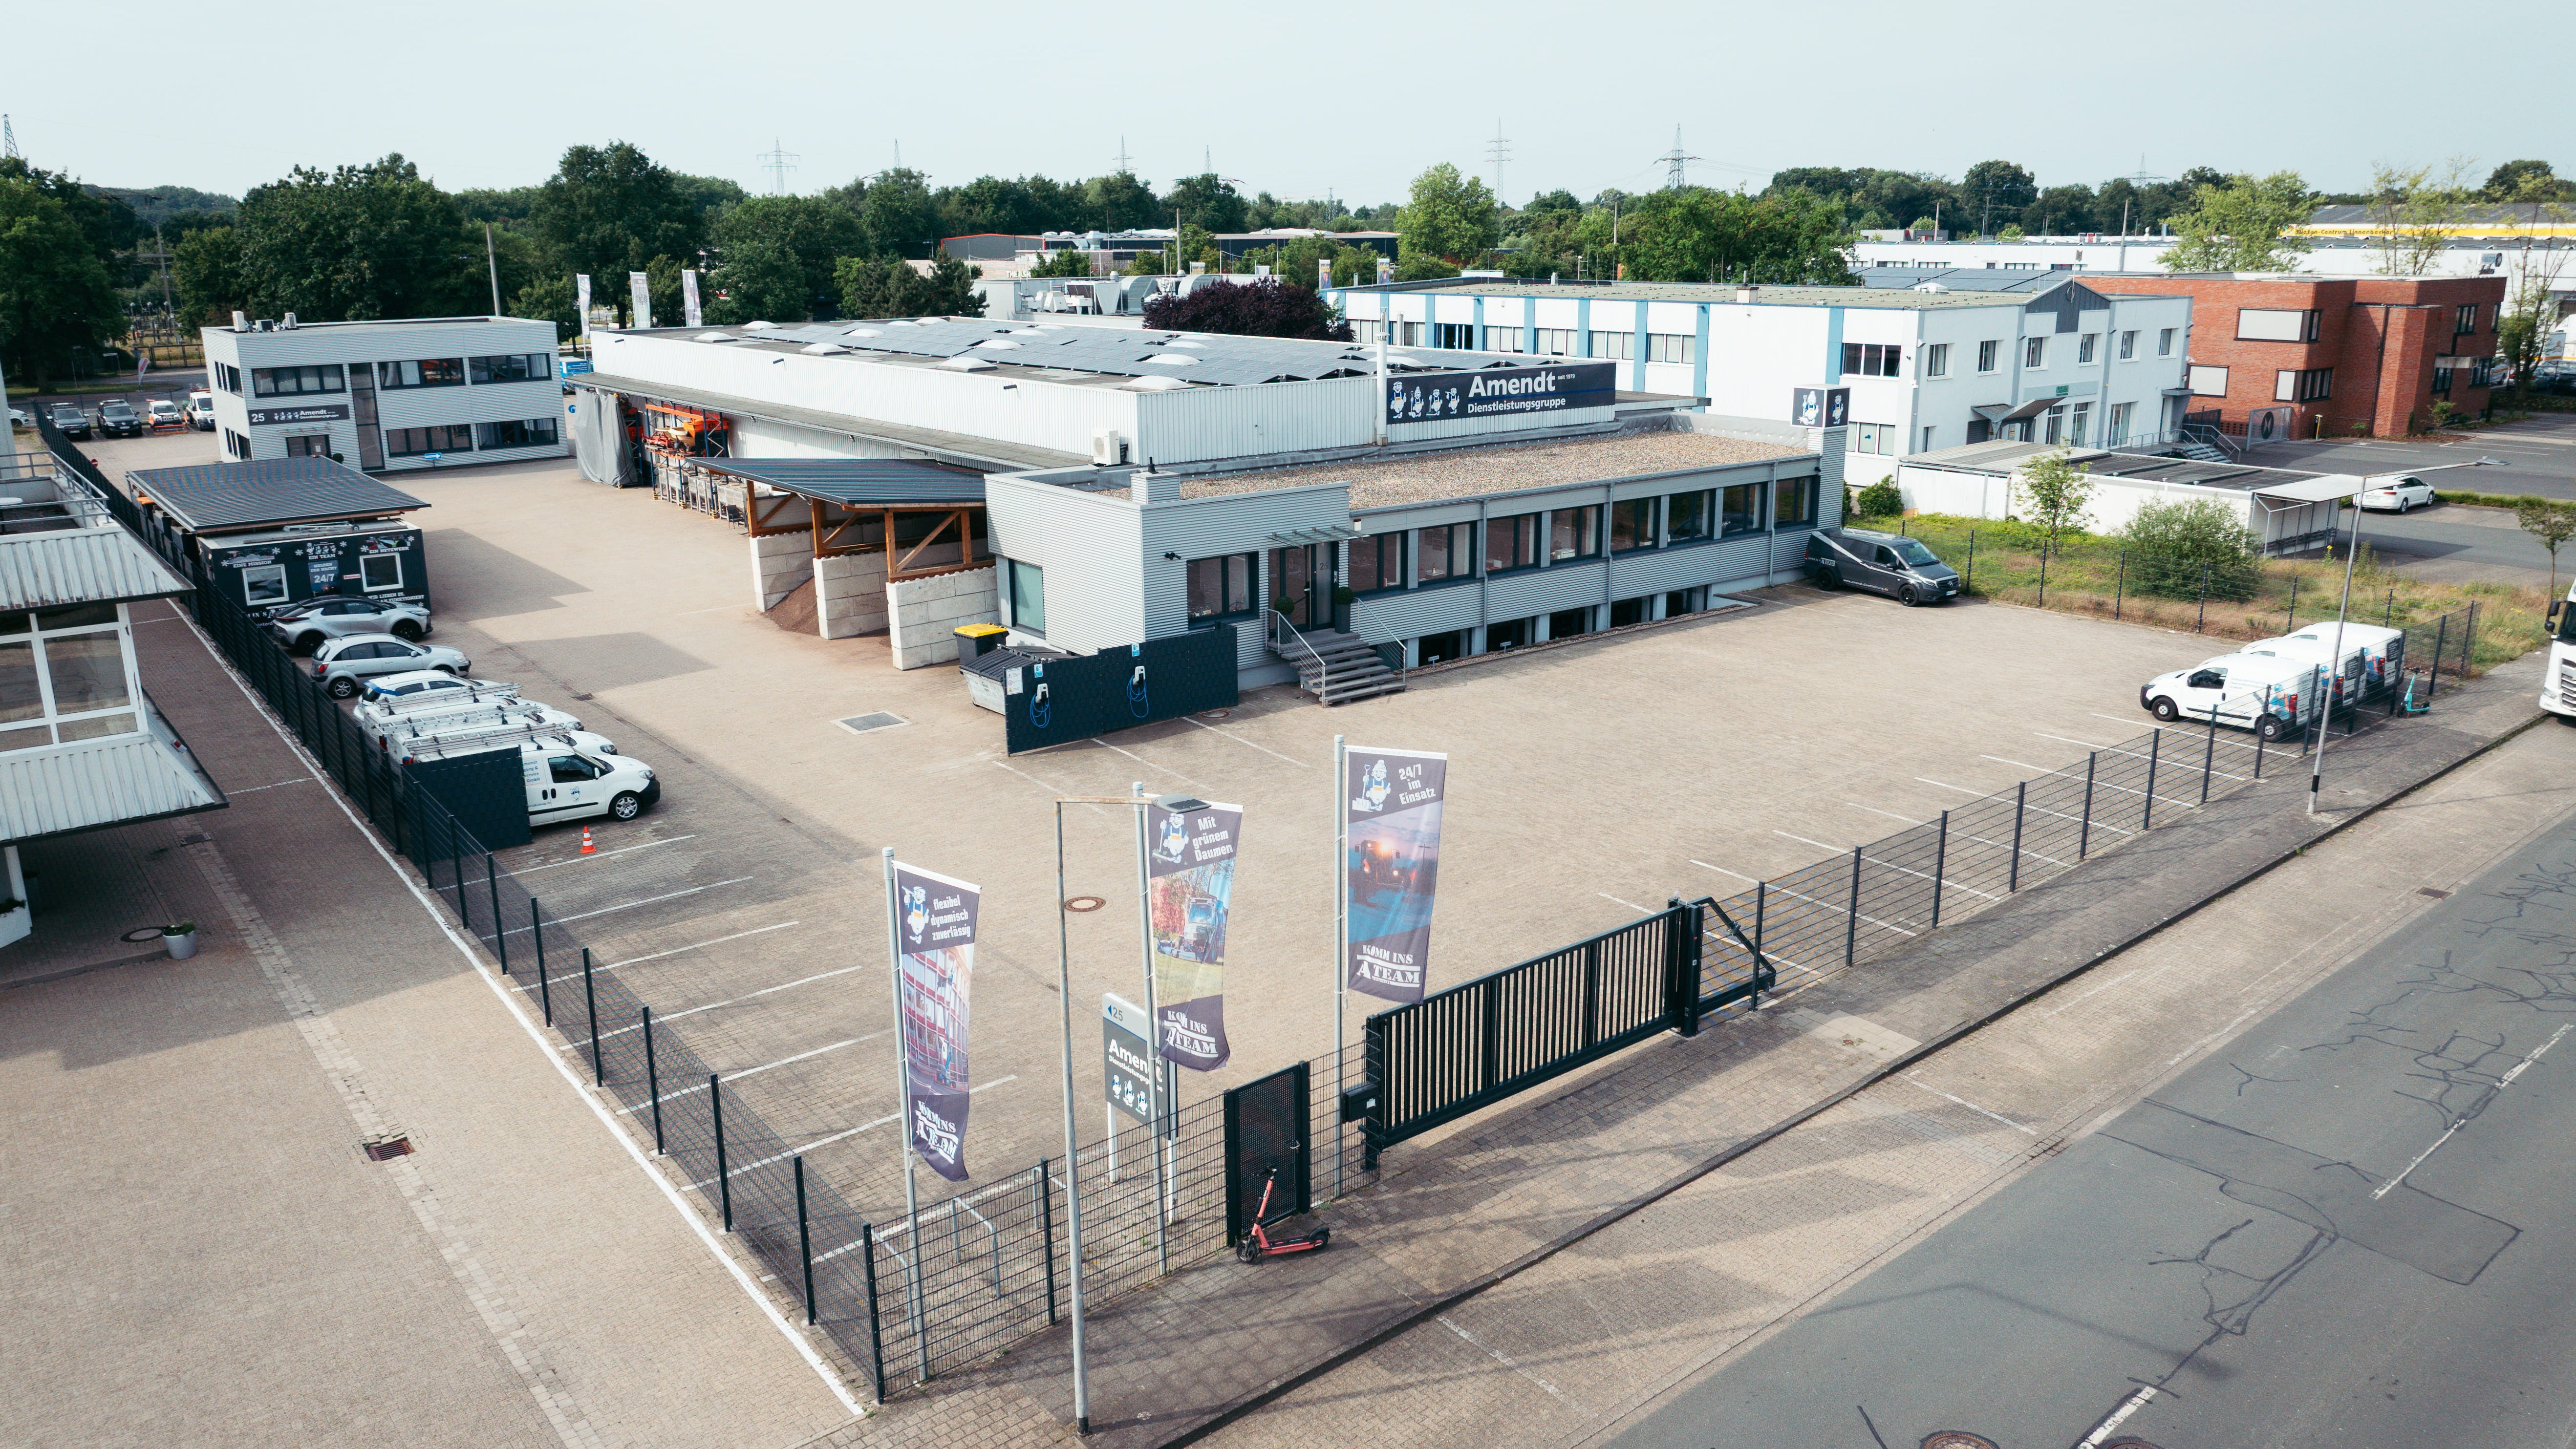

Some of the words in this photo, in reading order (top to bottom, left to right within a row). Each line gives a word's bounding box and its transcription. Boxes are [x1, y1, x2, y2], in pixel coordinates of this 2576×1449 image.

[1468, 371, 1555, 398] Amendt
[1468, 398, 1566, 413] Dienstleistungsgruppe
[252, 413, 265, 422] 25
[314, 574, 335, 583] 24/7
[1398, 763, 1421, 780] 24/7
[1407, 779, 1421, 790] im
[1399, 788, 1436, 805] Einsatz
[1197, 816, 1217, 831] Mit
[1192, 830, 1229, 849] grünem
[1194, 844, 1233, 861] Daumen
[933, 894, 961, 910] flexibel
[930, 908, 968, 927] dynamisch
[932, 923, 971, 941] zuverlässig
[1362, 944, 1390, 961] KOMM
[1393, 952, 1413, 964] INS
[1356, 960, 1371, 979] A
[1373, 964, 1420, 983] TEAM
[1113, 1007, 1123, 1022] 25
[1190, 1020, 1207, 1034] INS
[1176, 1031, 1218, 1054] TEAM
